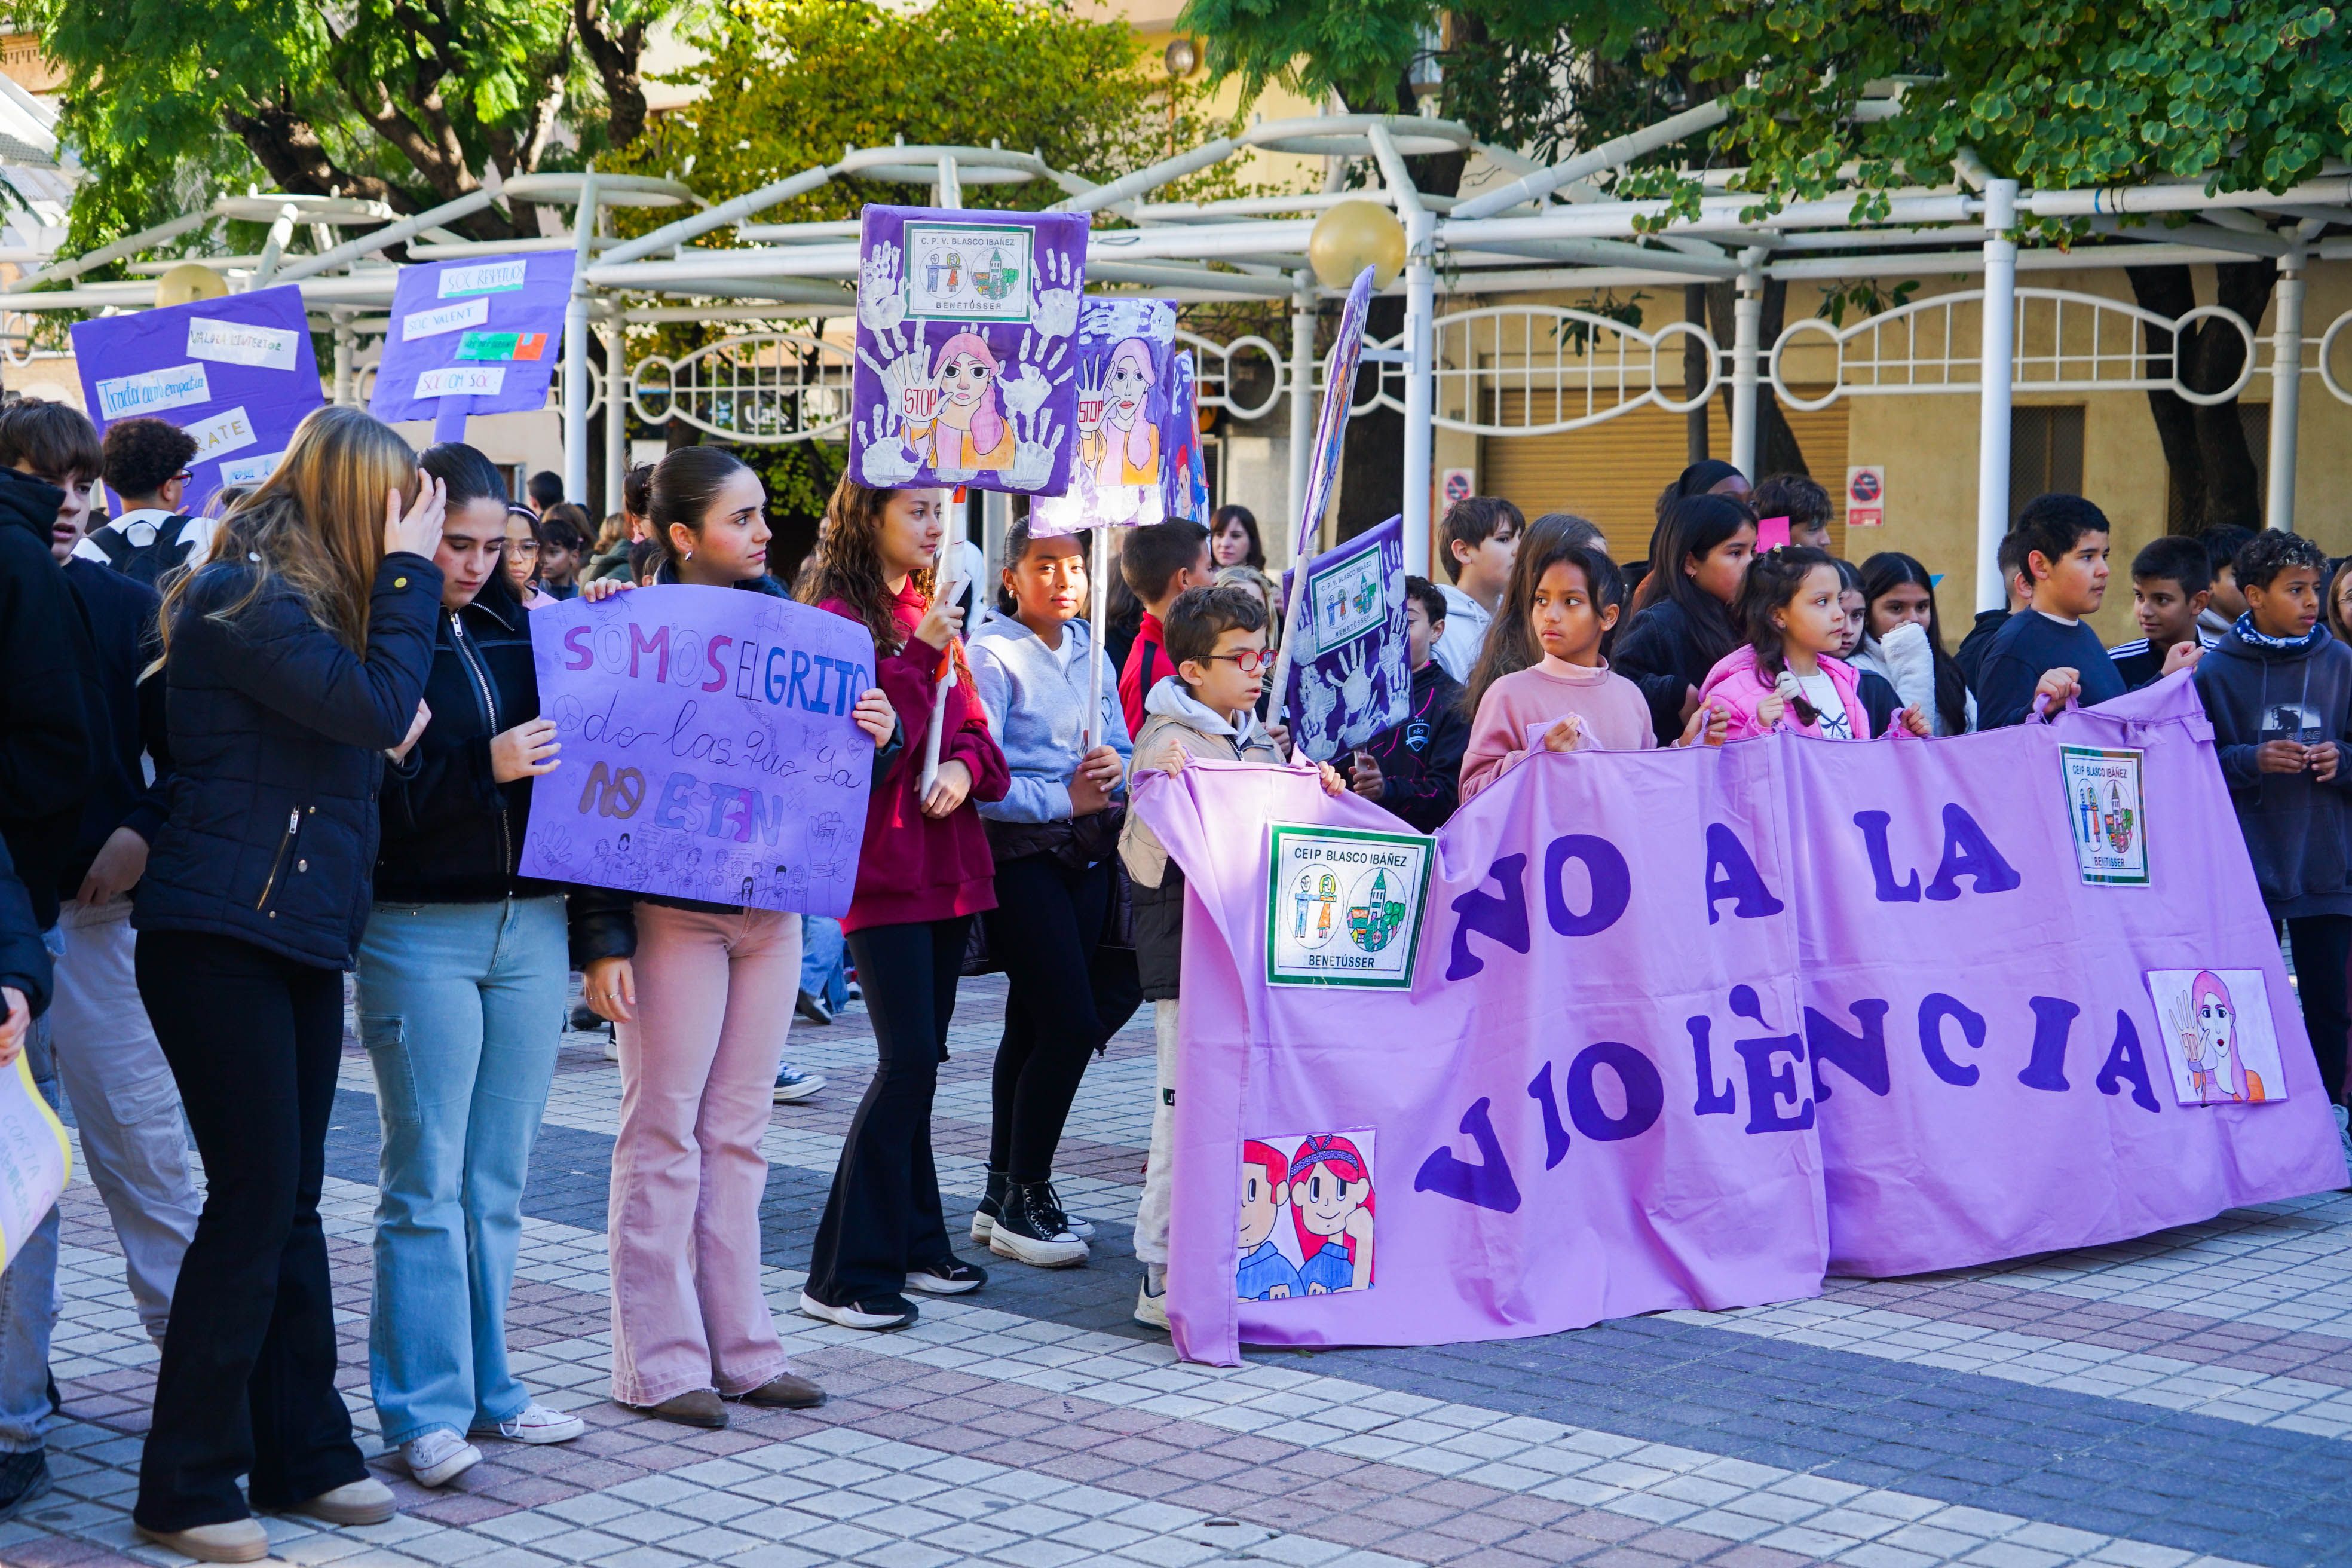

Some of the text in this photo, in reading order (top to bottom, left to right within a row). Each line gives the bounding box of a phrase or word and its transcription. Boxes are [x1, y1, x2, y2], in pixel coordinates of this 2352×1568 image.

[433, 307, 474, 326] VALENT
[936, 299, 1002, 310] BENETÚSSER
[905, 388, 937, 416] STOP
[1079, 400, 1103, 422] STOP
[193, 420, 246, 452] RATE
[564, 623, 733, 692] SOMOS
[765, 647, 870, 716] GRITO
[584, 689, 659, 748] de
[663, 700, 739, 765] las
[742, 731, 806, 777] que
[2073, 765, 2084, 775] CEIP
[2087, 766, 2105, 777] BLASCO
[578, 761, 646, 819] NO
[1294, 847, 1407, 867] CEIP BLASCO IBÁÑEZ
[1446, 803, 2021, 981] NO A LA
[1309, 954, 1374, 968] BENETÚSSER
